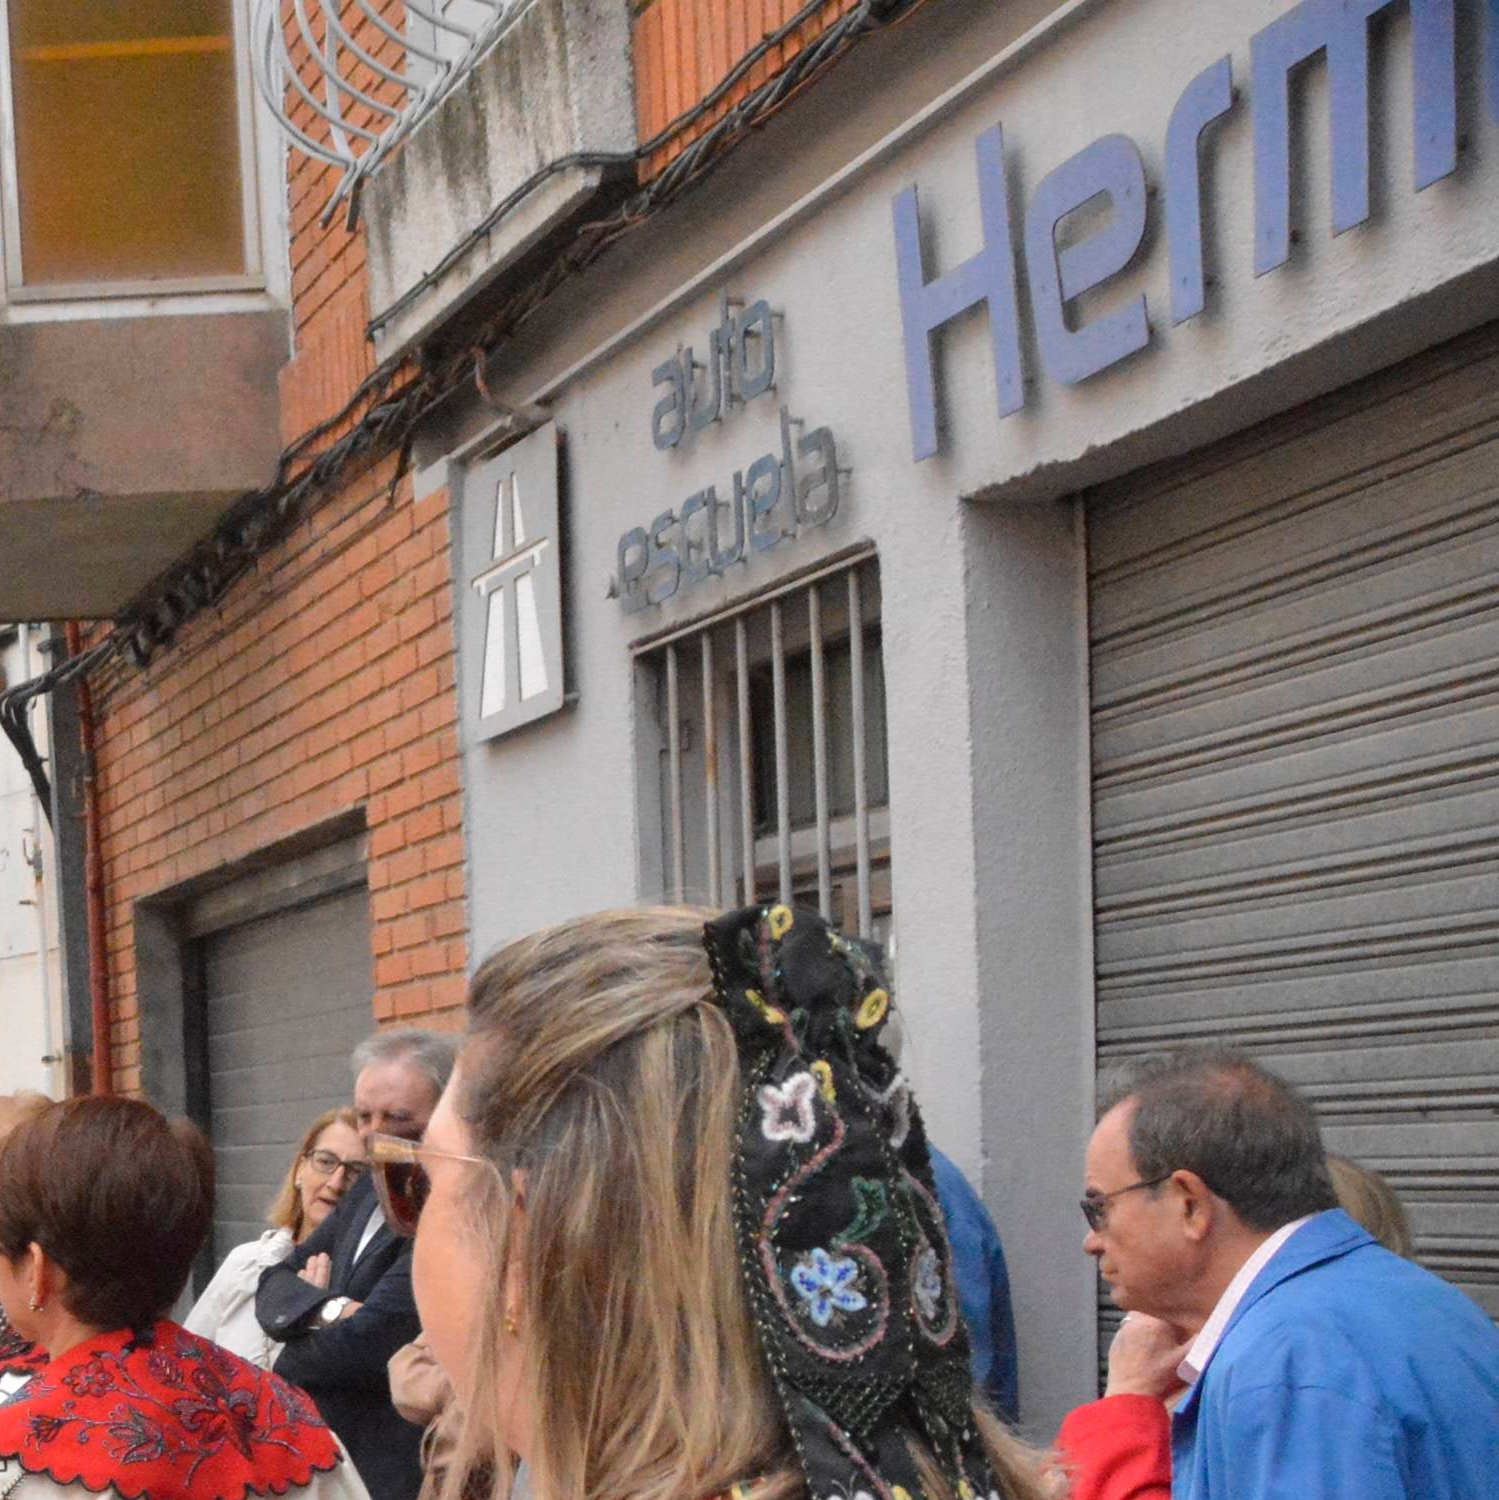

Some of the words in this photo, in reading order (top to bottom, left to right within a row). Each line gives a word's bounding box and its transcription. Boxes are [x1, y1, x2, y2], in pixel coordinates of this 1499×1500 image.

[892, 0, 1499, 462] Herm
[652, 287, 775, 450] auto
[618, 404, 839, 616] escuela
